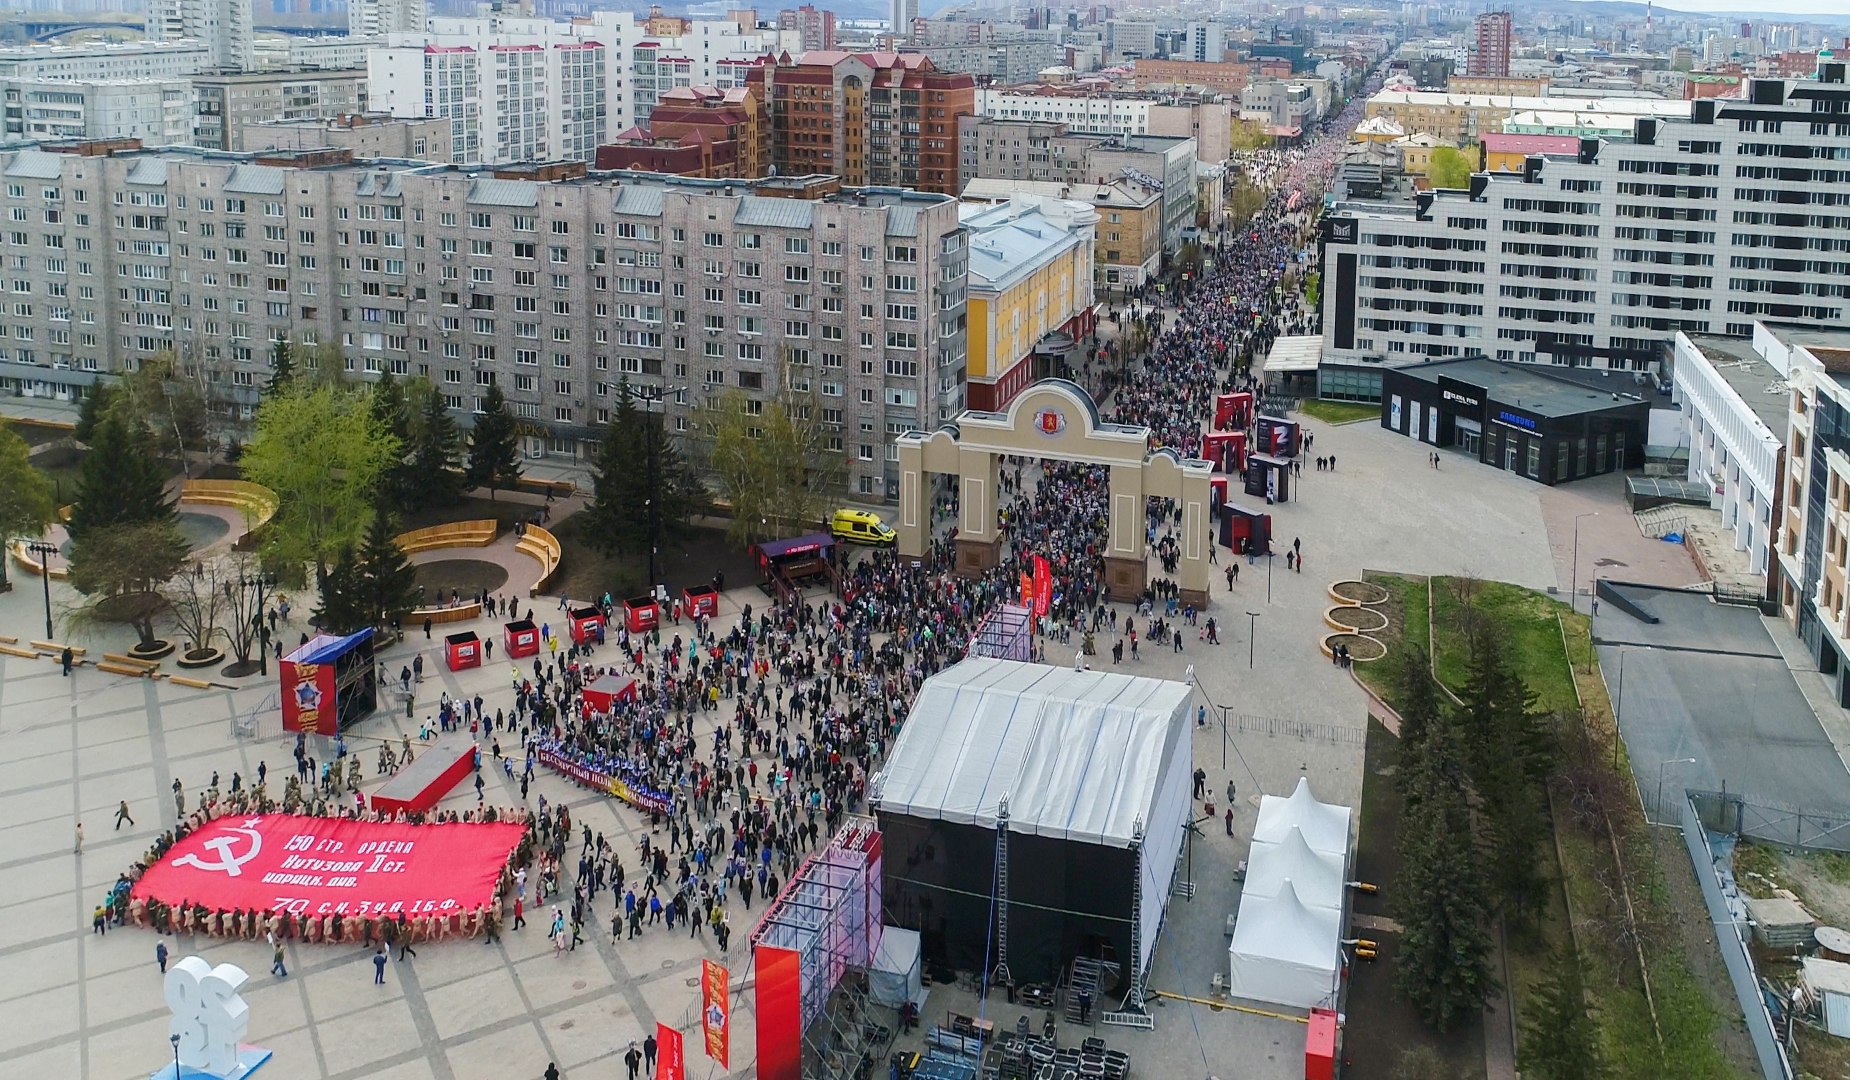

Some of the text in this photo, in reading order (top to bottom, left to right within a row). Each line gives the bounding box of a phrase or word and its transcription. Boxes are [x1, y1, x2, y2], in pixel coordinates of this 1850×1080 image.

[1500, 411, 1535, 428] SAMSUNG
[592, 773, 613, 789] ПОЛК
[283, 834, 315, 851] 150
[357, 841, 414, 854] ОРДЕНА
